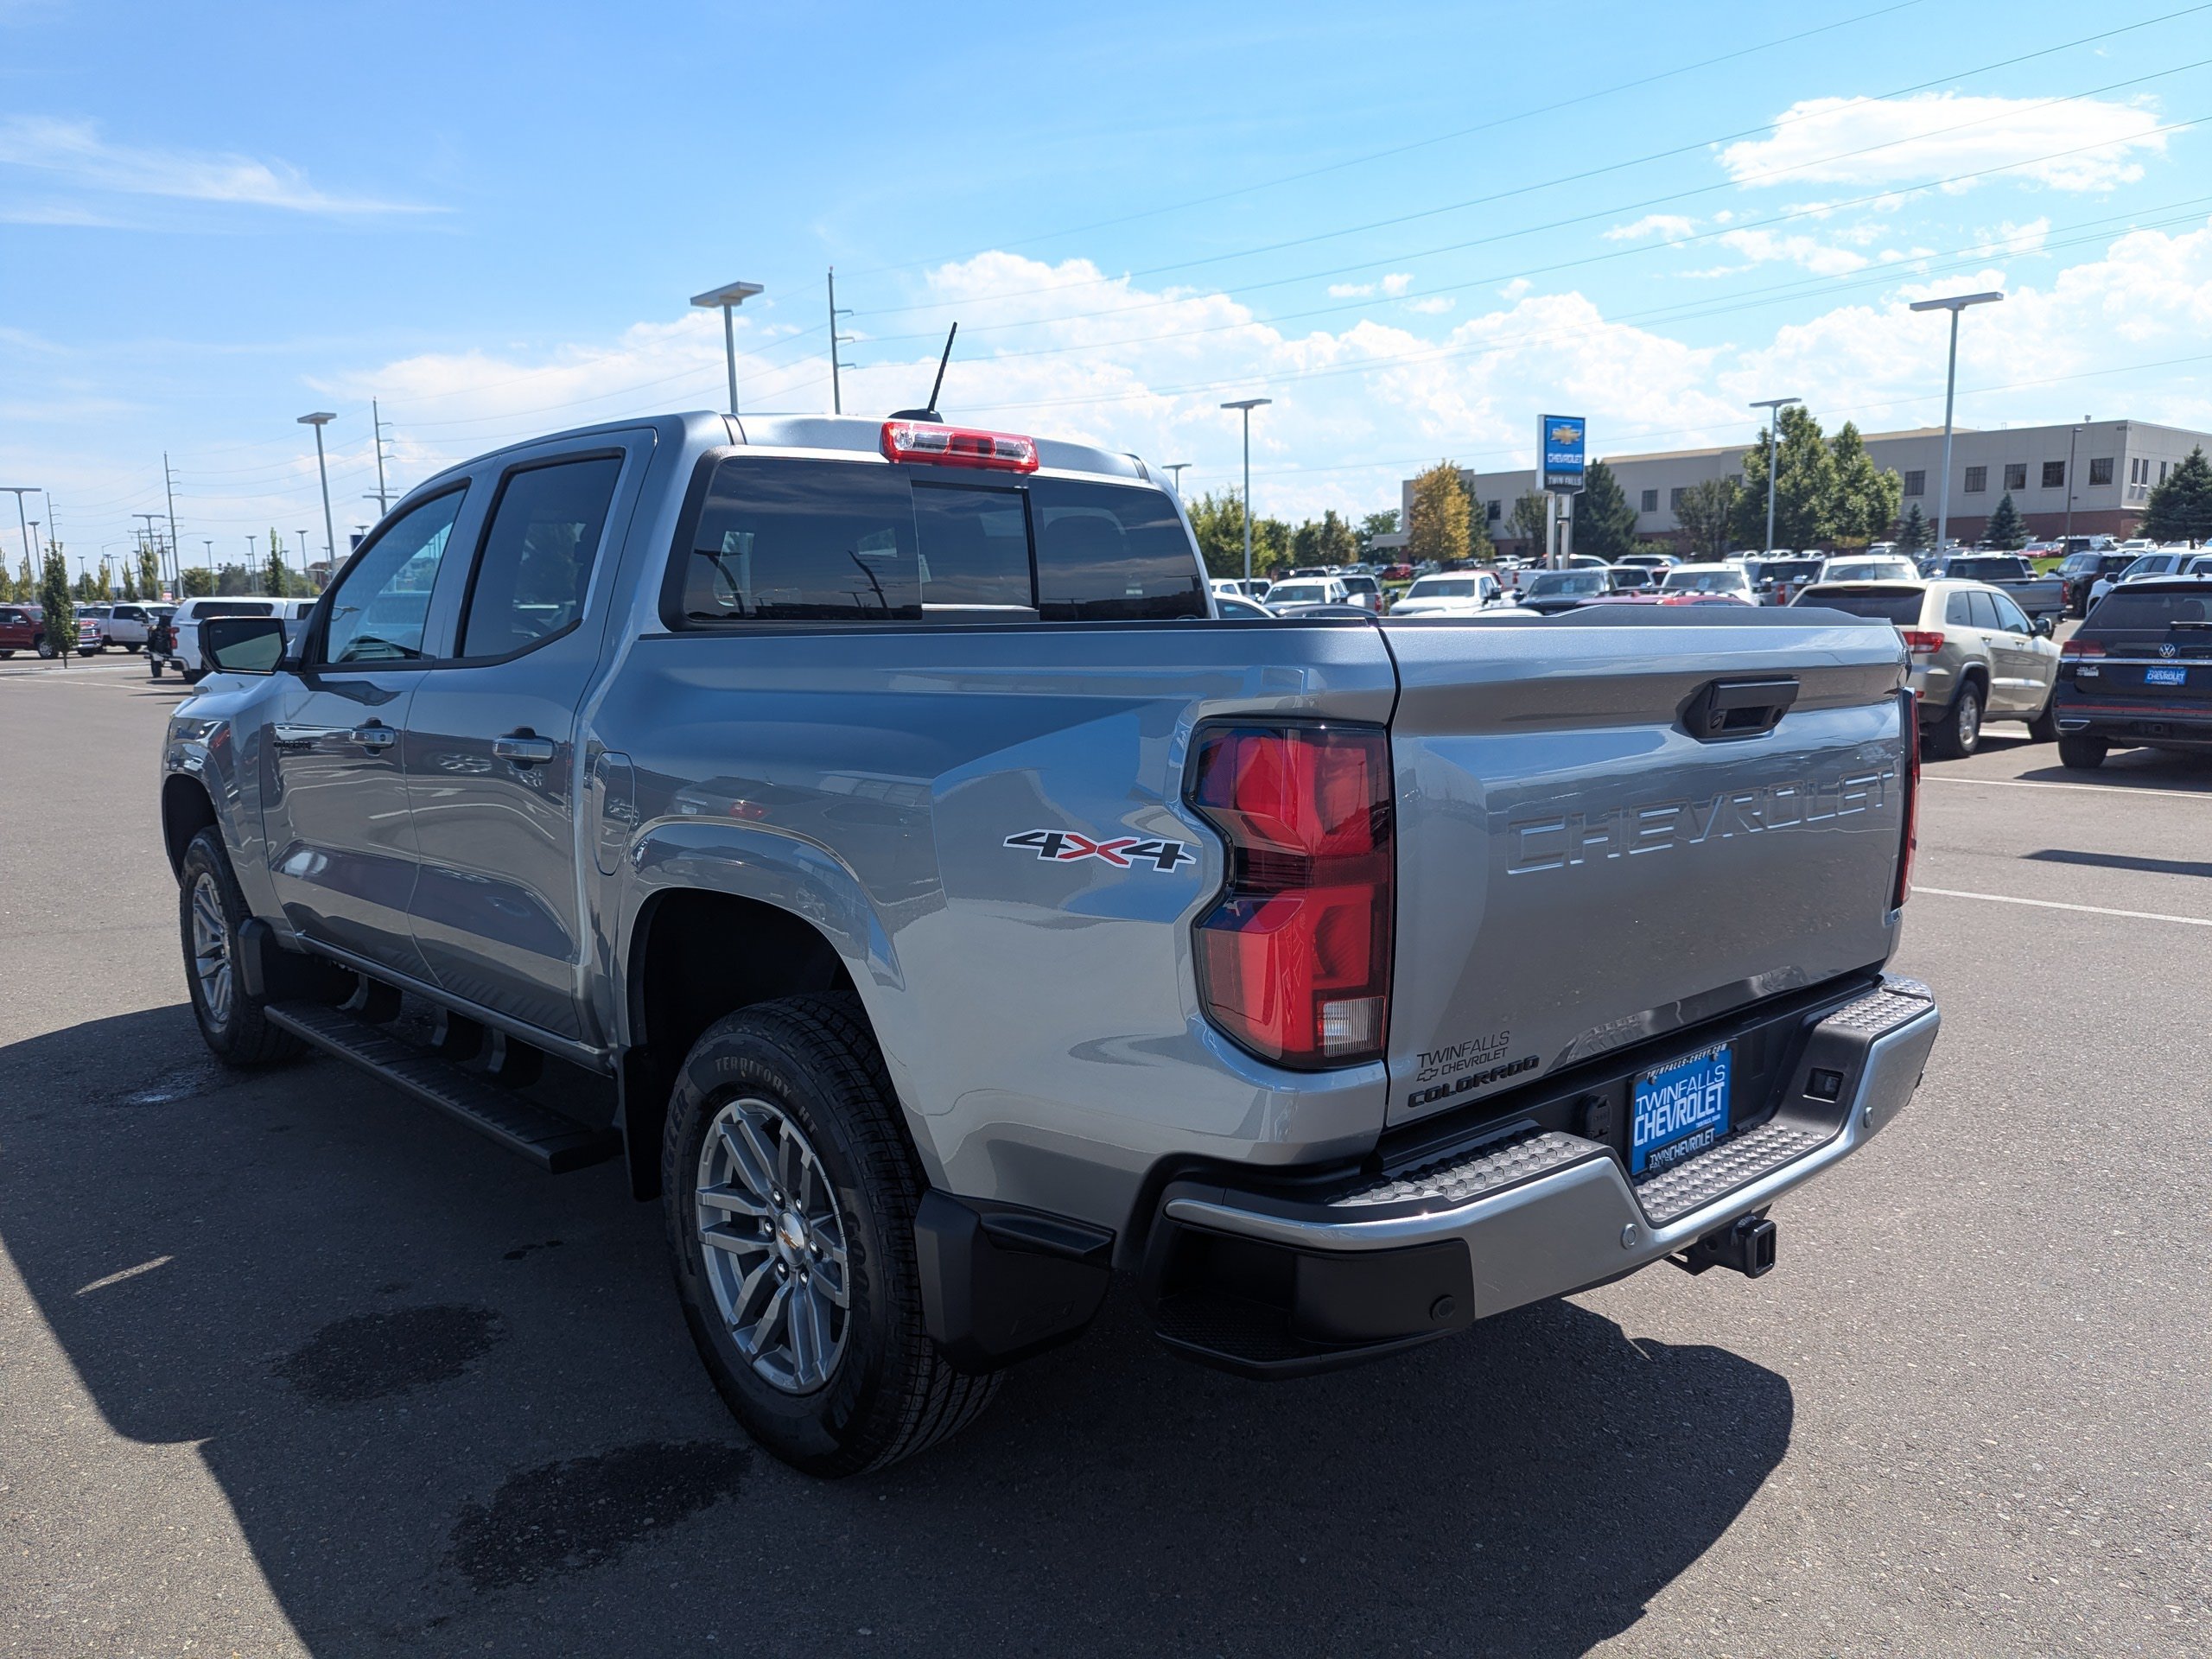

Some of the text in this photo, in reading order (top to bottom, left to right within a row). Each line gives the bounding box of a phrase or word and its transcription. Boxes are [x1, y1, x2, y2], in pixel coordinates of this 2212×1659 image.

[1548, 453, 1583, 463] CHEVROLET
[1548, 476, 1582, 486] TWIN FALLS
[1507, 768, 1895, 875] CHEVROLET
[1441, 1047, 1508, 1076] CHEVROLET
[715, 1056, 819, 1133] TERRITORY HT
[1408, 1054, 1541, 1108] COLORADO
[1634, 1082, 1726, 1147] CHEVROLET
[1649, 1148, 1670, 1165] TWIN
[1669, 1128, 1715, 1162] CHEVROLET
